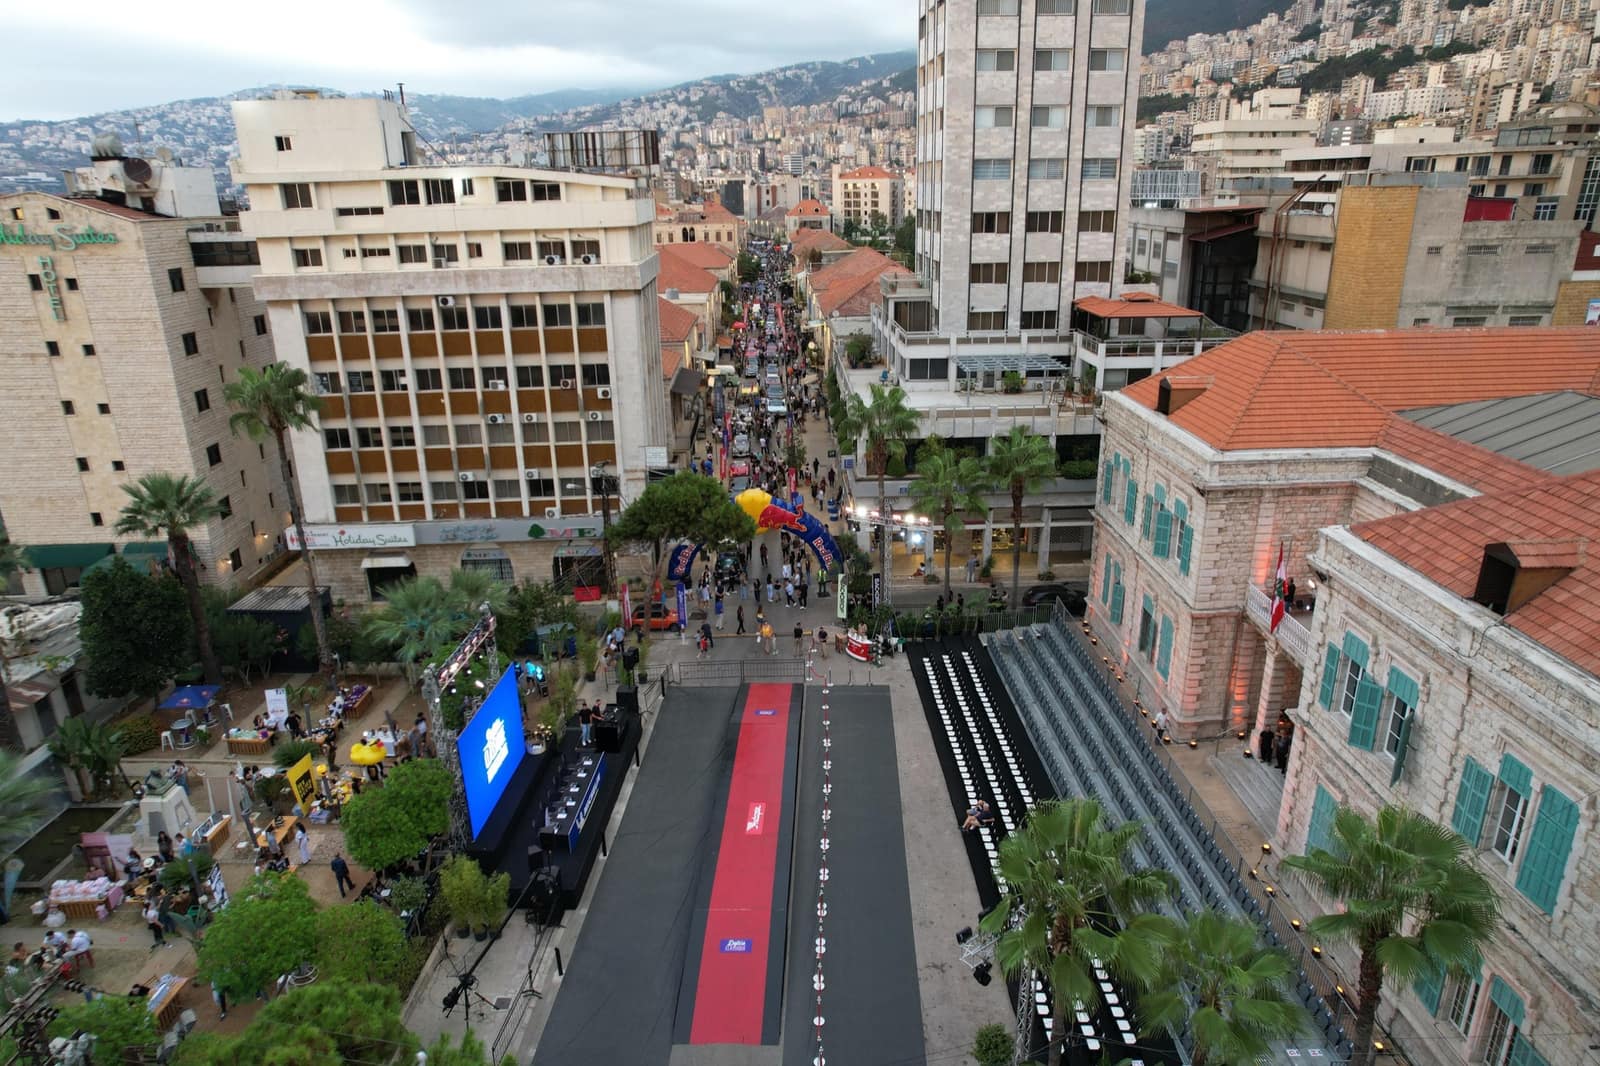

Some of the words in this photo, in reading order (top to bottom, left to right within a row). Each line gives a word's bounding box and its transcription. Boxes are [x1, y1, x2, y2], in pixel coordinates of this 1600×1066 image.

[54, 224, 118, 251] Suites
[37, 256, 65, 321] HOTEL
[332, 535, 375, 546] Holiday
[375, 534, 408, 546] Suites
[812, 537, 829, 557] Red
